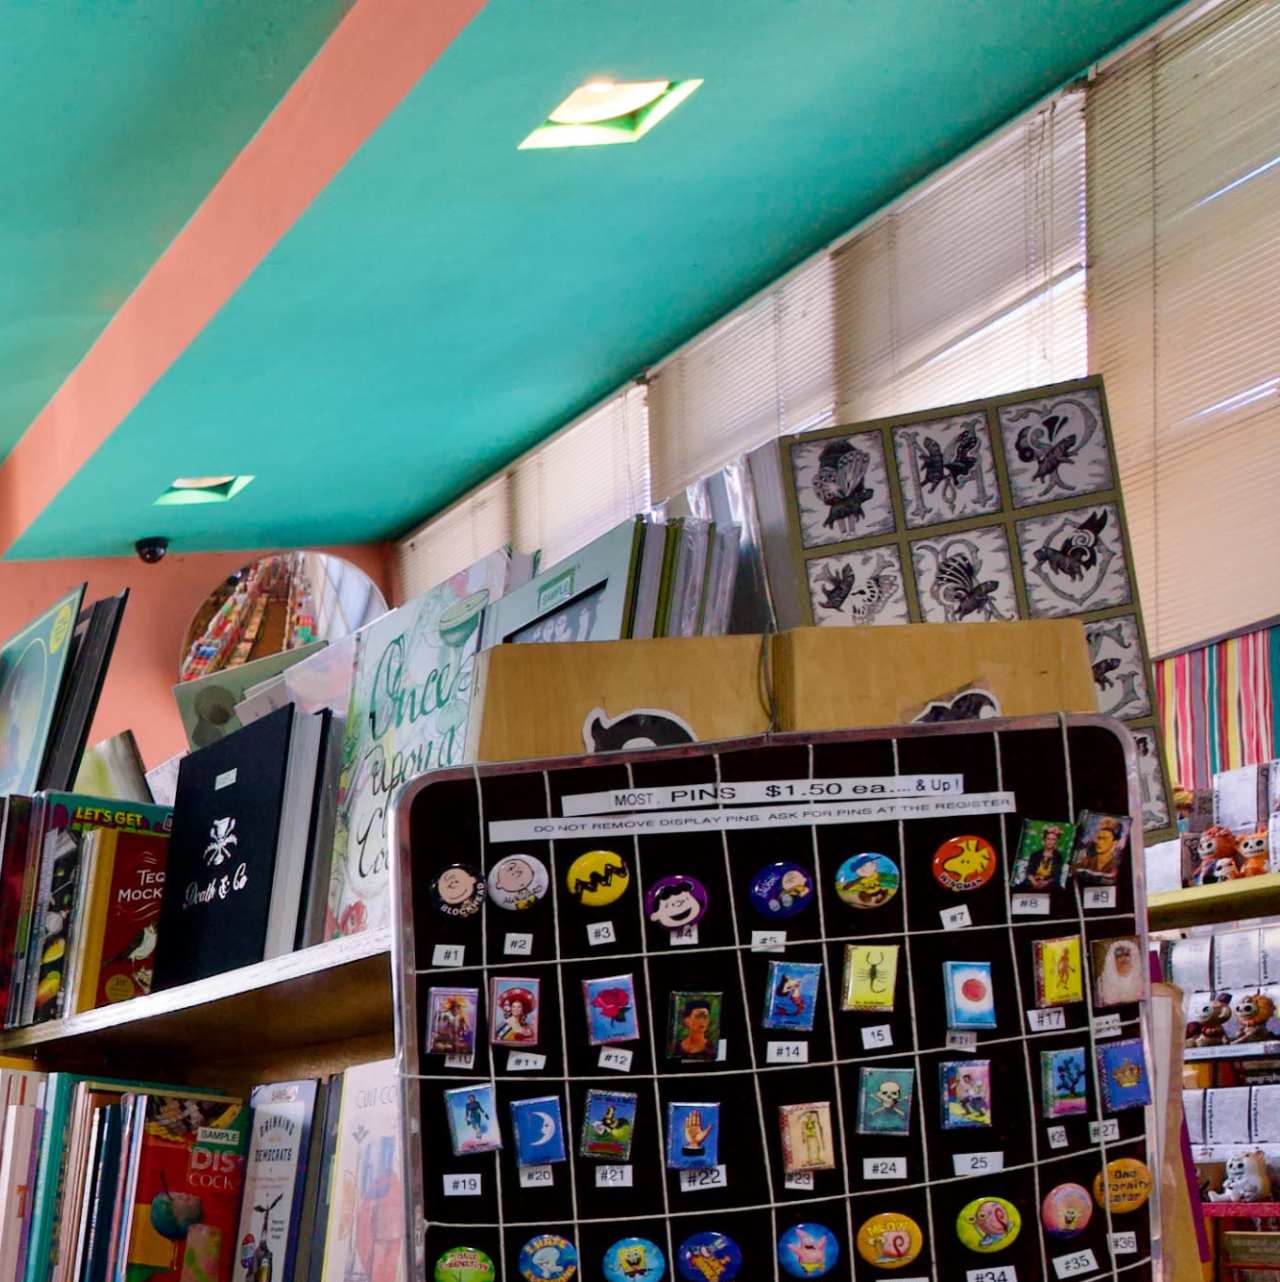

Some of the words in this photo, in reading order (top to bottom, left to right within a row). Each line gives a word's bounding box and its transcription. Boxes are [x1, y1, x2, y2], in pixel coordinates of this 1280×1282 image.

[671, 787, 736, 803] PINS
[765, 782, 842, 798] $1.50
[916, 779, 927, 792] &
[75, 806, 112, 823] LET'S
[114, 811, 143, 825] GET
[534, 824, 555, 833] DO
[558, 823, 586, 832] NOT
[591, 820, 655, 830] REMOVE
[659, 816, 722, 827] DISPLAY
[726, 814, 760, 823] PINS
[768, 810, 798, 820] ASK
[803, 808, 832, 818] FOR
[836, 806, 873, 817] PINS
[876, 804, 897, 814] AT
[901, 802, 930, 812] THE
[935, 798, 1012, 810] REGISTER
[940, 874, 983, 891] WINGMAN
[440, 882, 485, 916] BLOCKHEAD
[1092, 891, 1110, 904] #9
[949, 912, 965, 923] #7
[594, 926, 611, 939] #3
[510, 938, 527, 950] #2
[443, 949, 459, 961] #1
[870, 1030, 886, 1042] 15
[776, 1046, 800, 1057] #14
[604, 1055, 628, 1066] #12
[872, 1161, 897, 1174] #24
[970, 1157, 988, 1169] 25
[527, 1170, 551, 1182] #20
[600, 1169, 625, 1182] #21
[687, 1168, 721, 1188] #22
[451, 1178, 478, 1191] #19
[1064, 1255, 1090, 1272] #35
